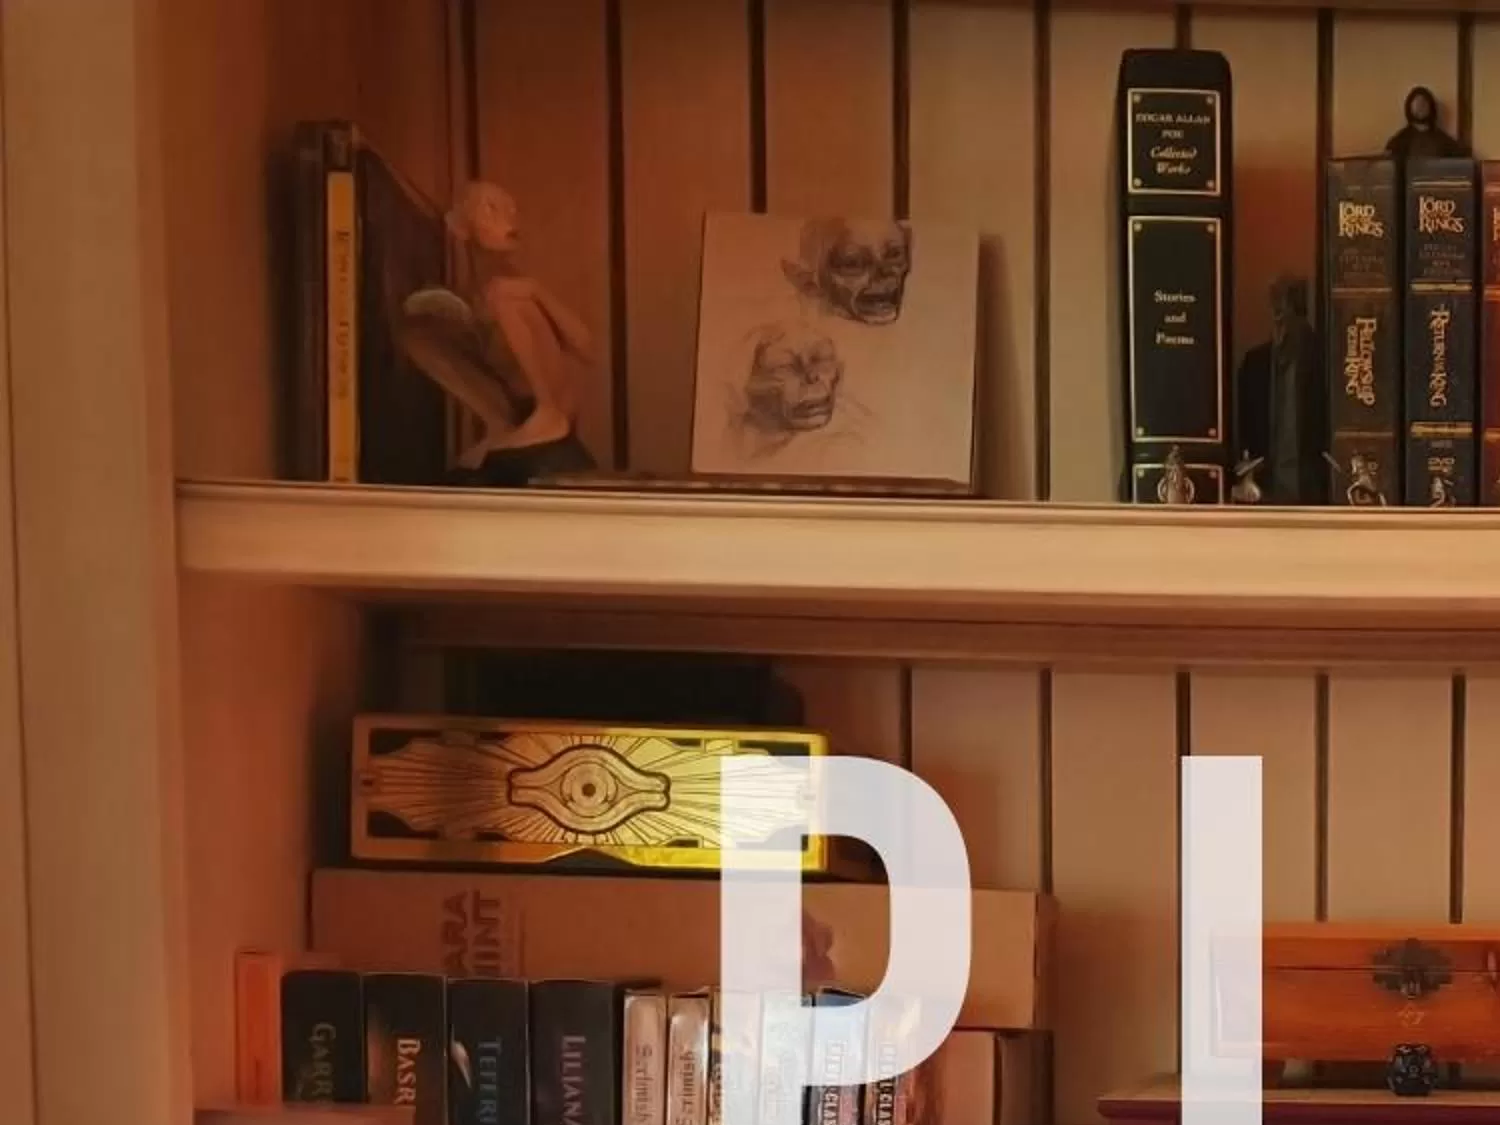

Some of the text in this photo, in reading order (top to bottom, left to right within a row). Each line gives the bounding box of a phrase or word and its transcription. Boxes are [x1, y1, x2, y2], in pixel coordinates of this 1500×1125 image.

[309, 1022, 338, 1109] GARR
[394, 1037, 421, 1105] BASR
[477, 1038, 501, 1124] TEFERI
